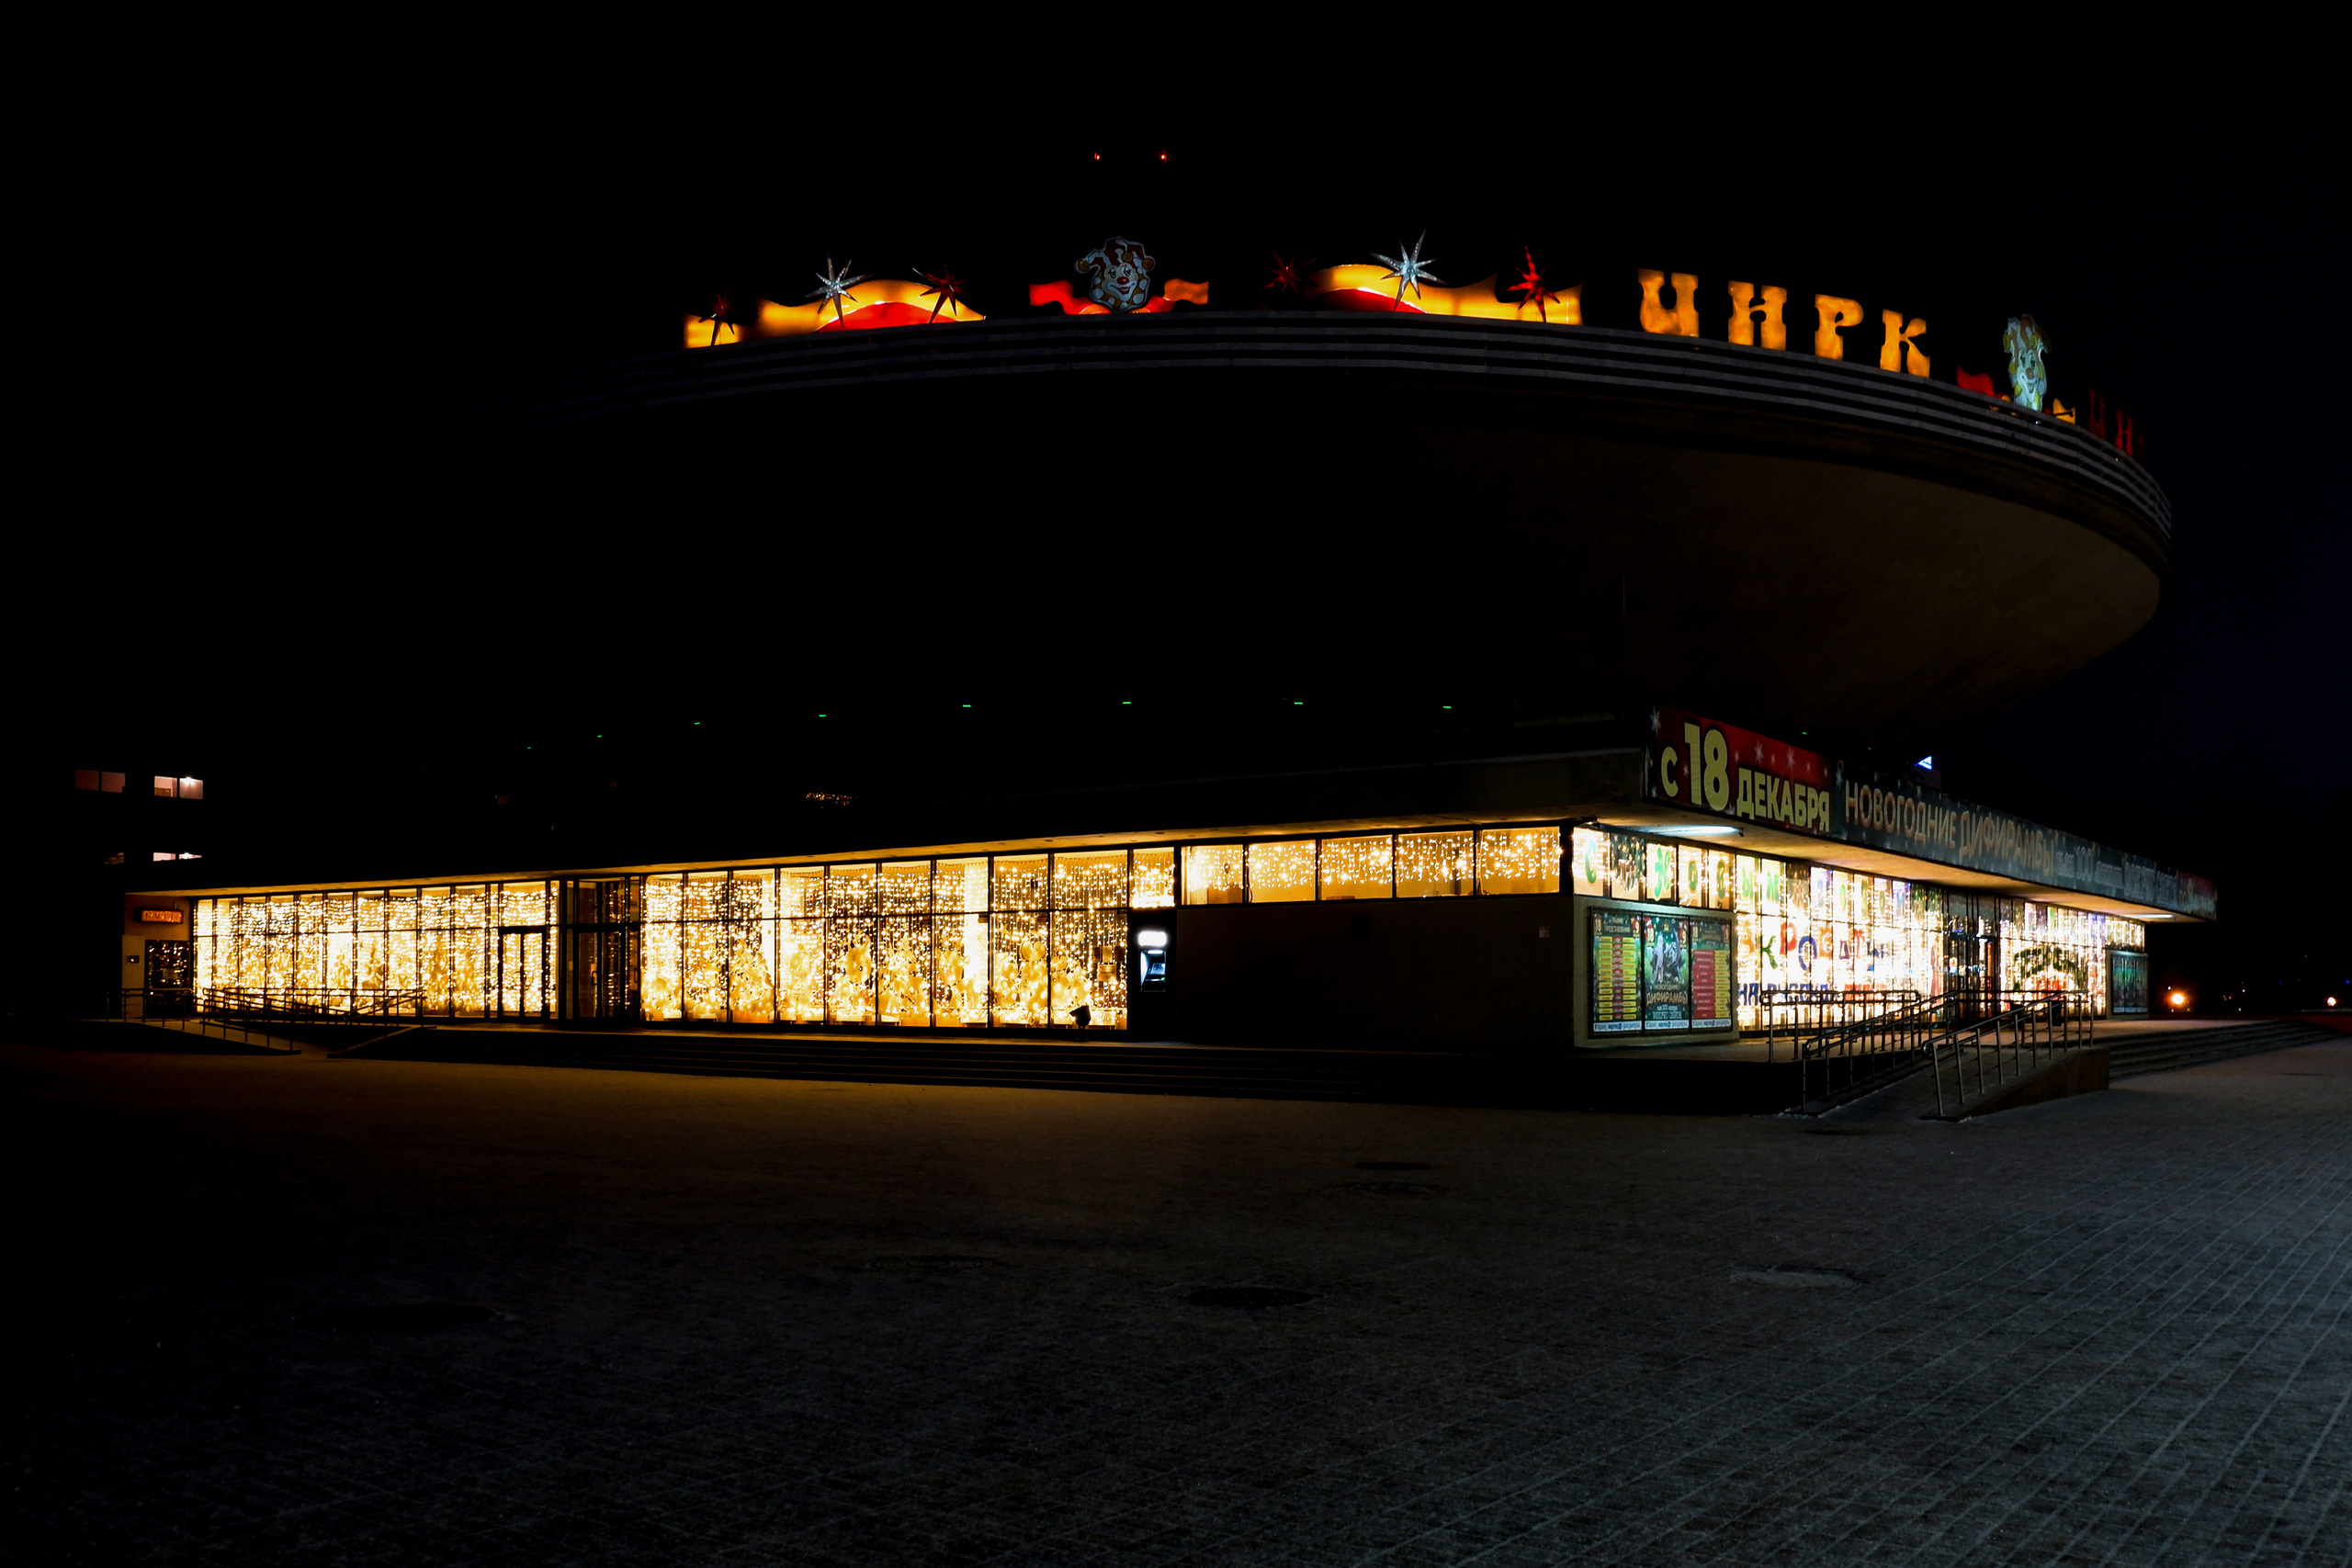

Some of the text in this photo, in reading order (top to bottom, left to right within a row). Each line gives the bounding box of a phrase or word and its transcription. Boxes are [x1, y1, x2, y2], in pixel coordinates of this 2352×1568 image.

[1638, 267, 1930, 378] ЦИРК
[1683, 721, 1730, 811] 18
[1736, 766, 1831, 833] ДЕКАБРЯ
[1845, 779, 1956, 849] НОВОГОДНИЕ
[1959, 809, 2055, 877] ДИФИРАМБЫ
